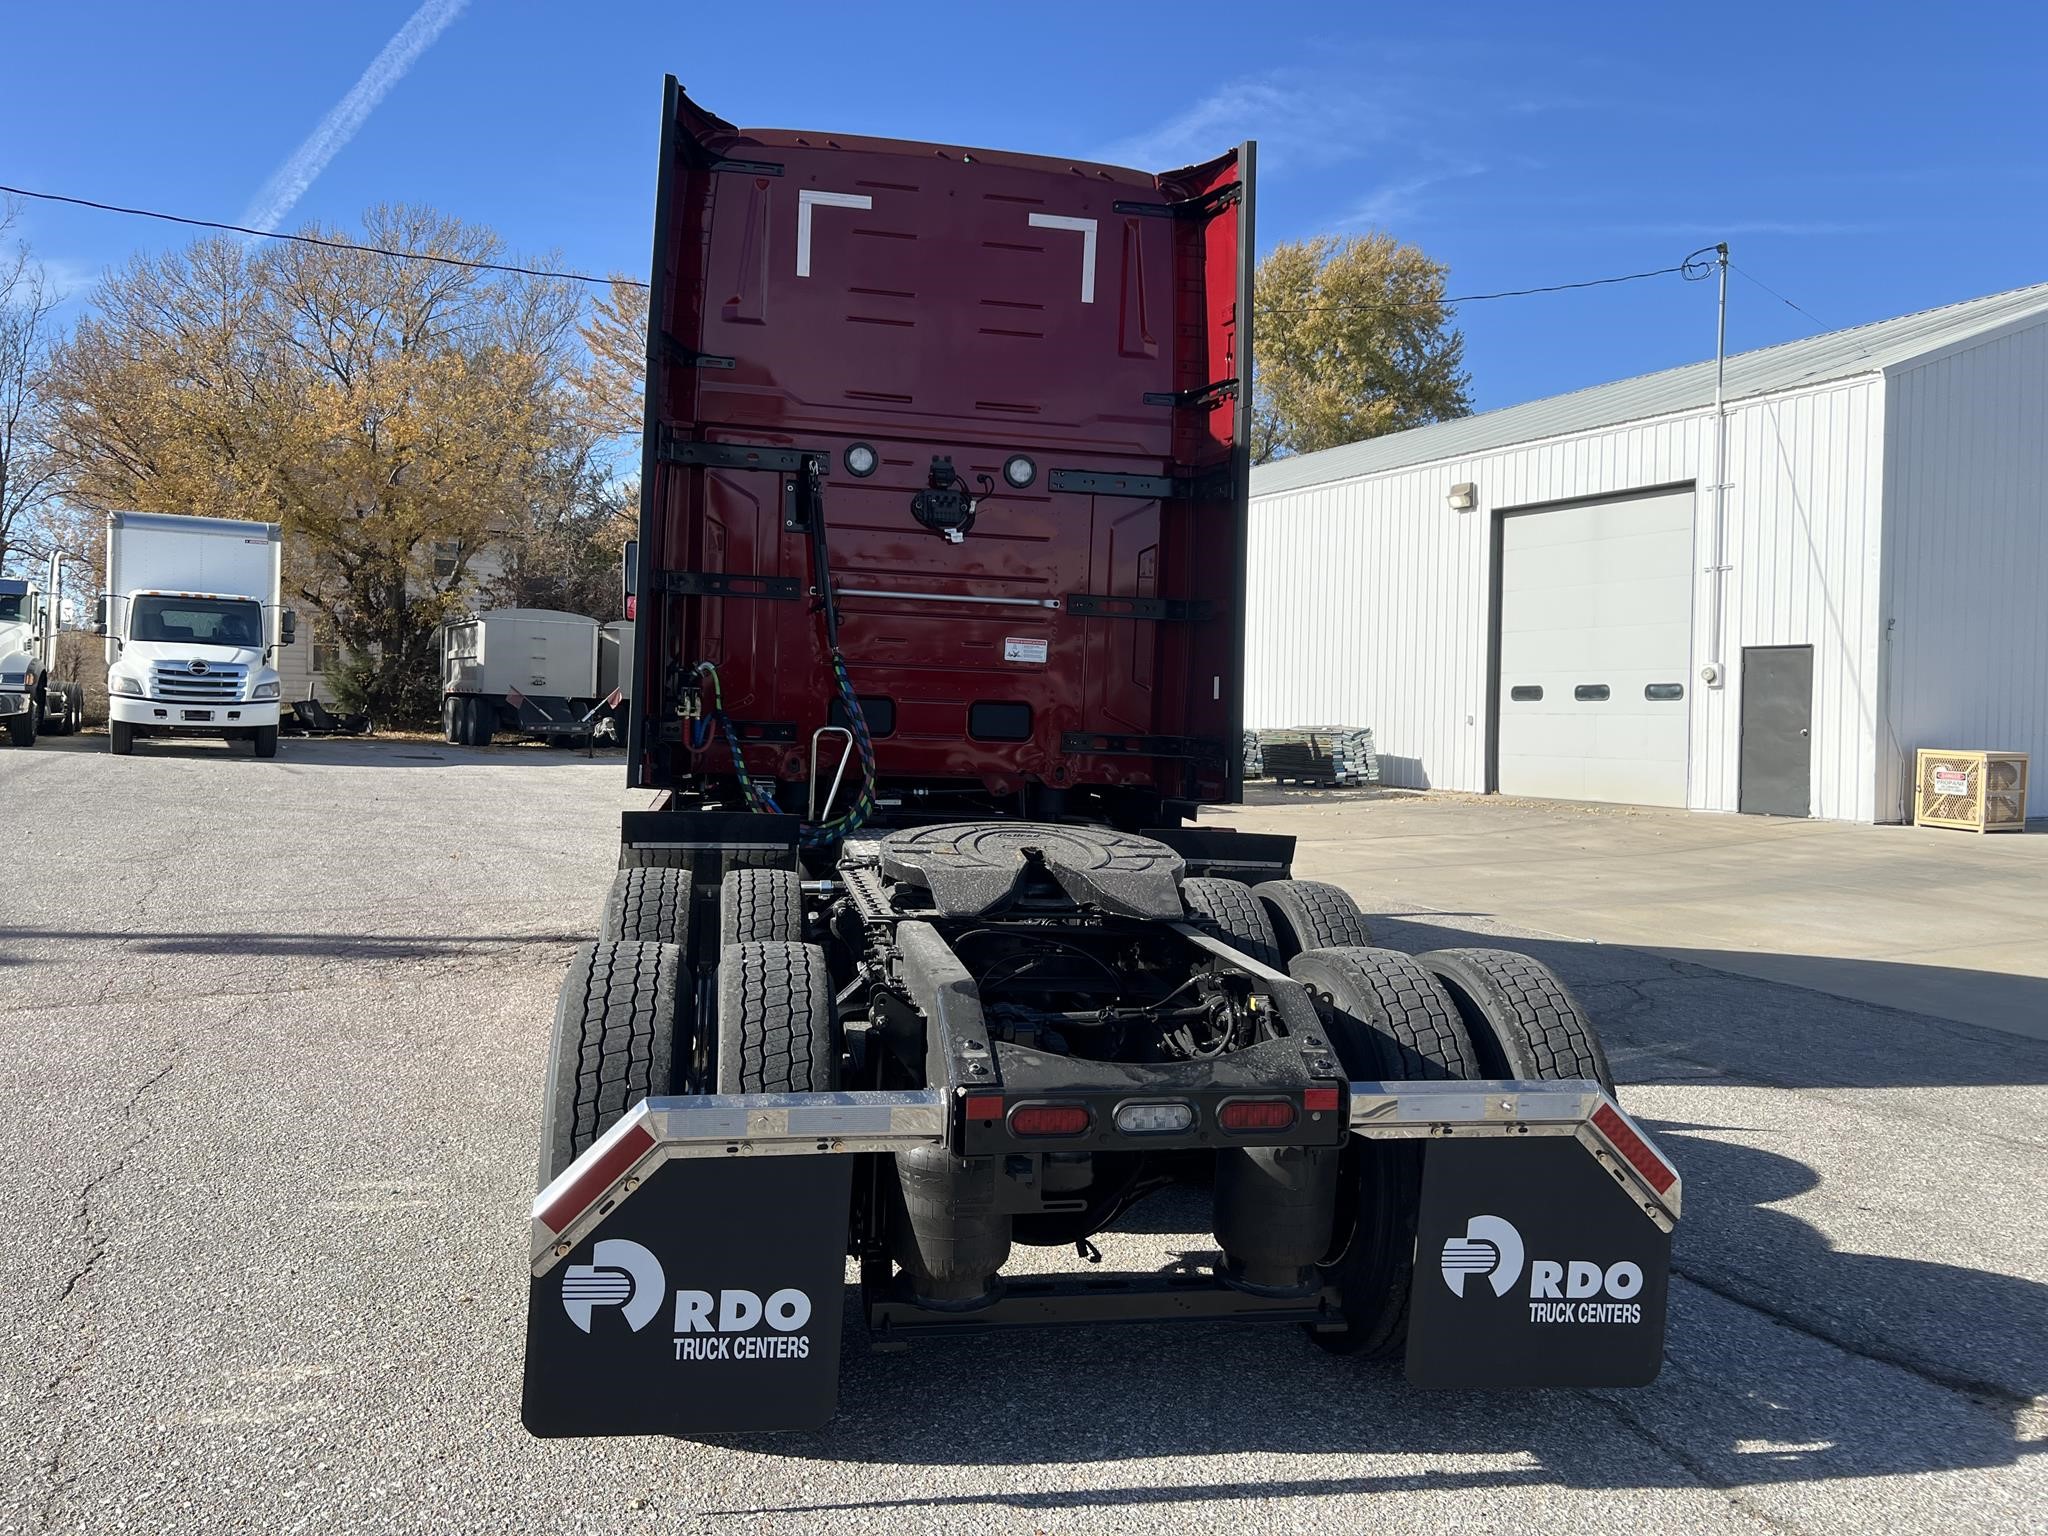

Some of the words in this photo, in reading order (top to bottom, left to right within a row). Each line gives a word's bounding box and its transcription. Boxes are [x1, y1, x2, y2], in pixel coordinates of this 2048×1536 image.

[1530, 1260, 1643, 1300] RDO
[674, 1288, 812, 1333] RDO
[1529, 1302, 1575, 1323] TRUCK
[1577, 1303, 1641, 1324] CENTERS
[674, 1337, 730, 1361] TRUCK
[733, 1336, 810, 1360] CENTERS
